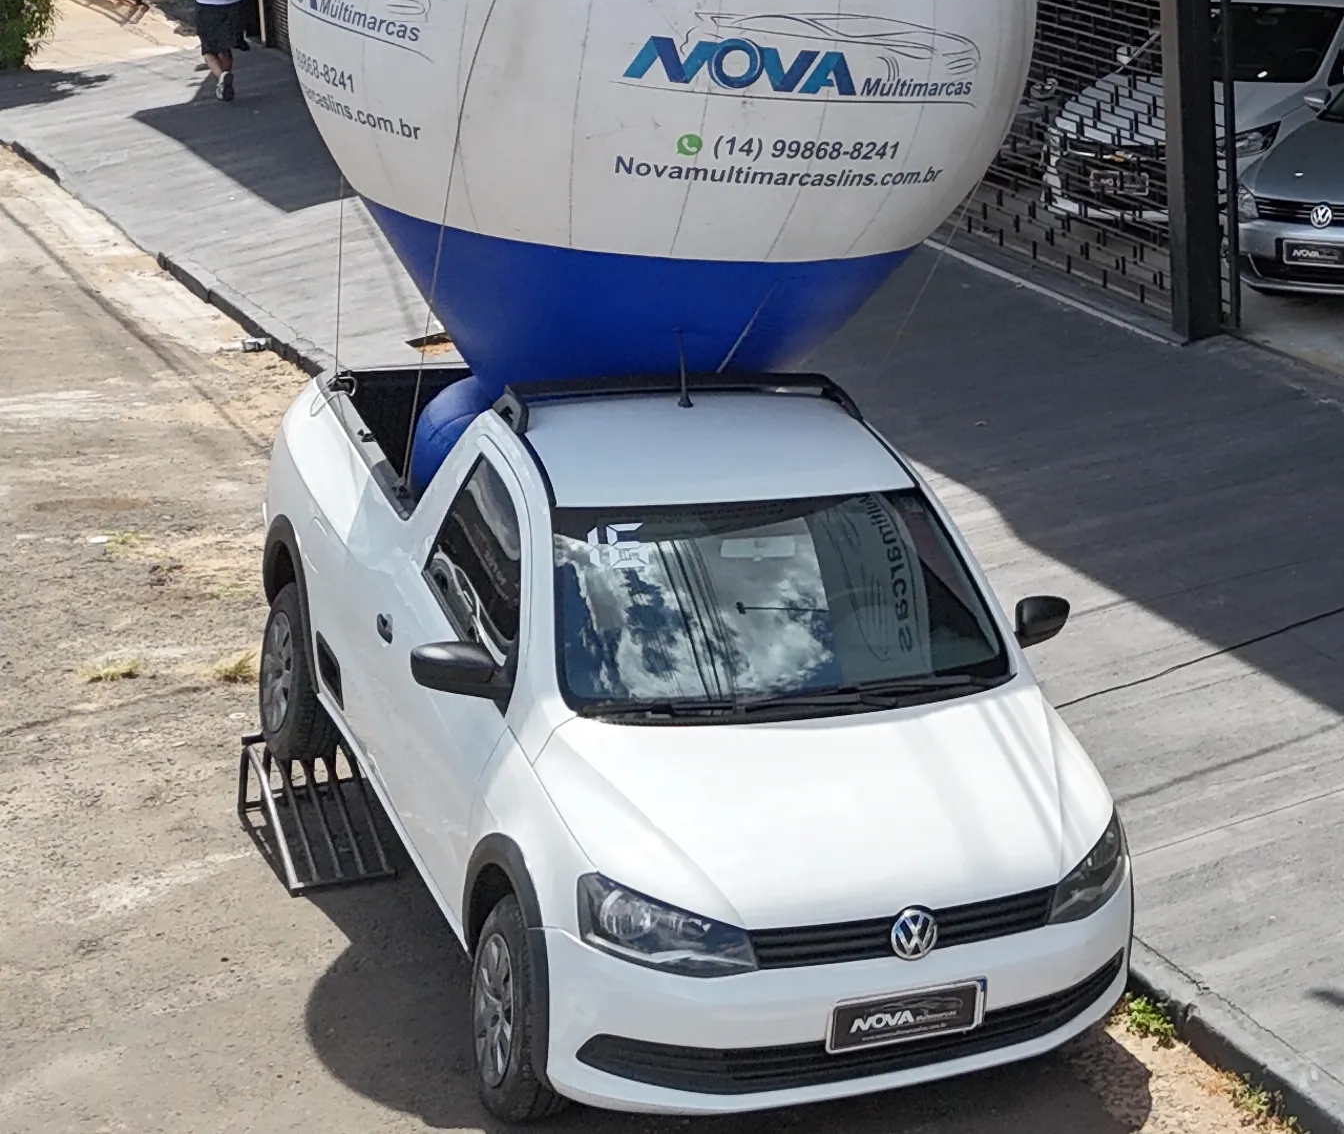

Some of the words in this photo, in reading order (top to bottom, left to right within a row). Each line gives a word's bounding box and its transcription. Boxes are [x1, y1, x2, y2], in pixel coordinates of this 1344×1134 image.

[622, 34, 857, 97] NOVA
[860, 74, 973, 100] Multimarcas
[713, 134, 763, 162] (14)
[771, 136, 900, 162] 99868-8241
[615, 155, 942, 188] Novamultimarcaslins.com.br
[850, 1009, 914, 1033] NOVA
